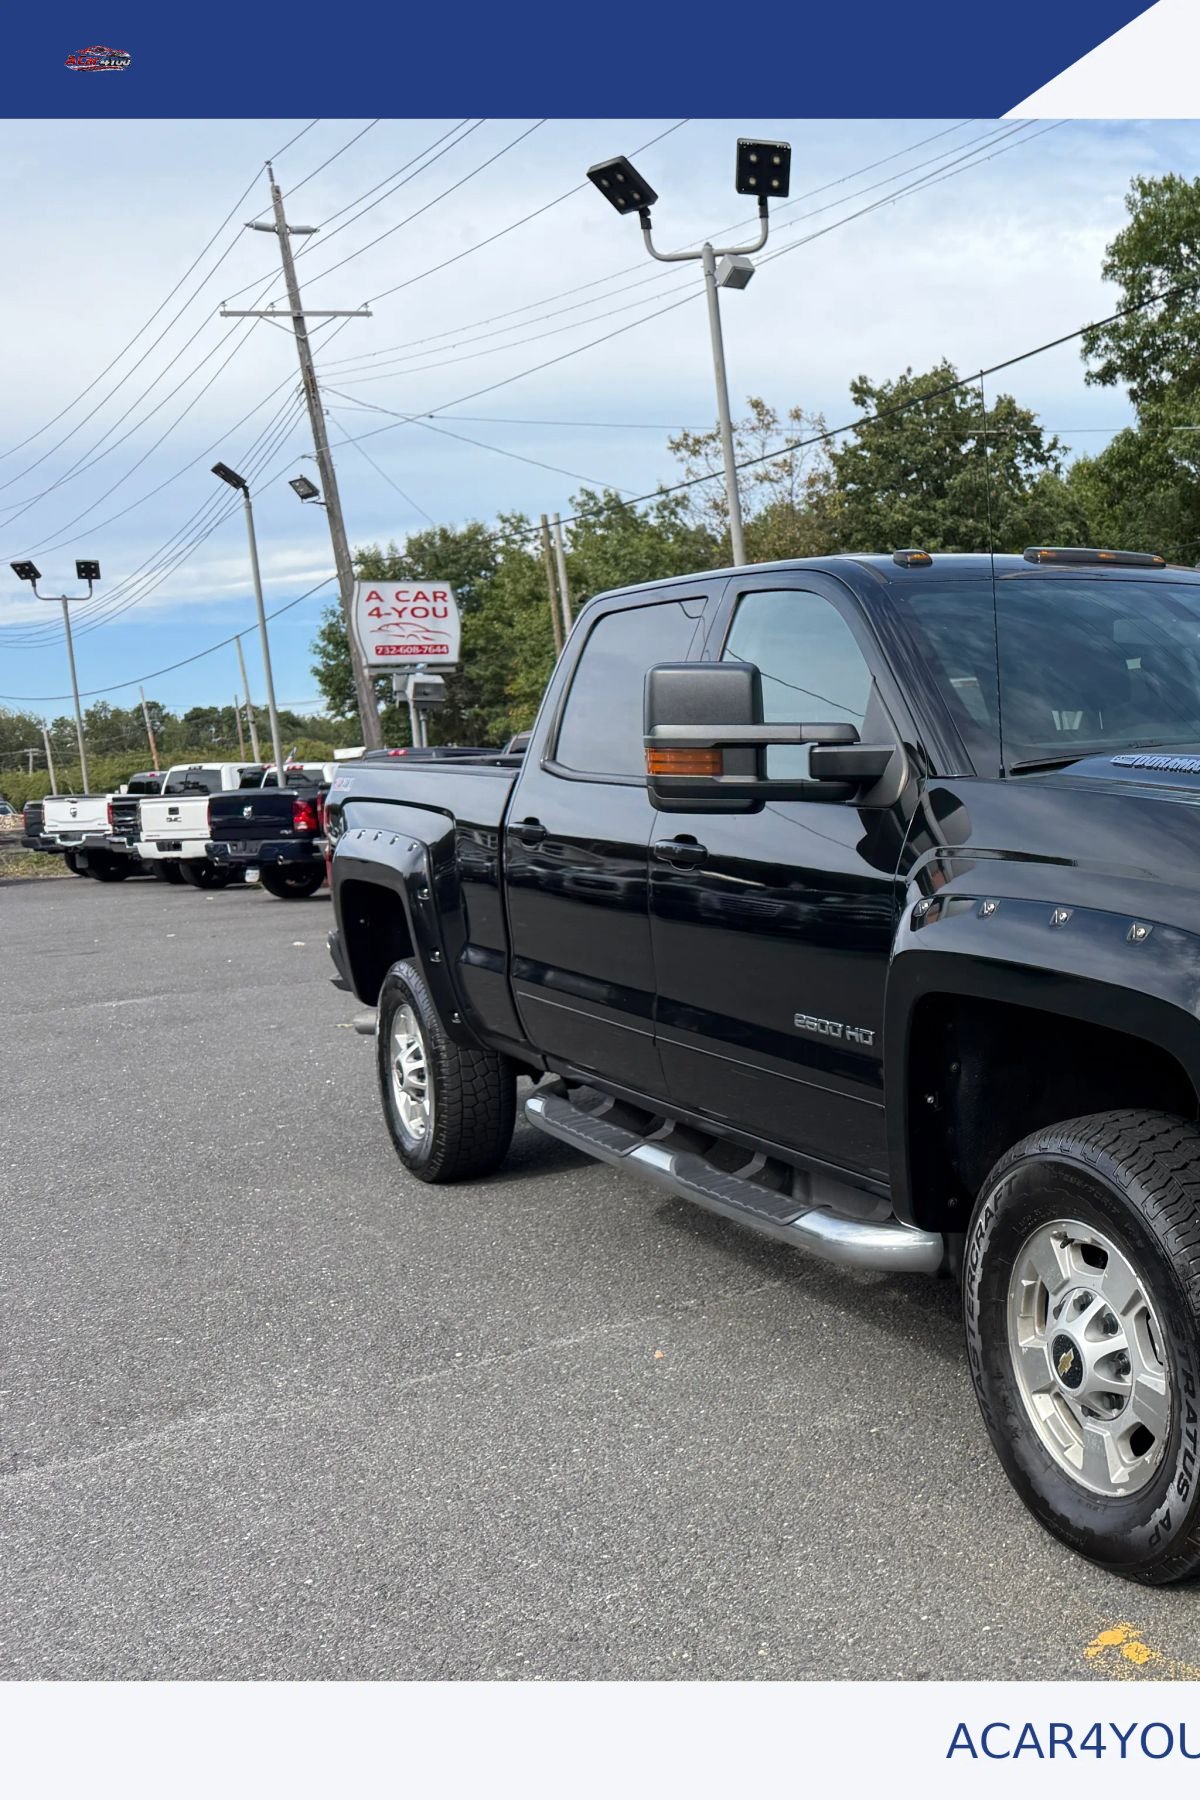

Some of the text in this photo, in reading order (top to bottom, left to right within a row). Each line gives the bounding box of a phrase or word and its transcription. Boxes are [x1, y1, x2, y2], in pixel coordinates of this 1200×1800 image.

[365, 590, 448, 602] A CAR
[368, 606, 448, 619] 4-YOU
[376, 646, 447, 655] 732-608-7644
[794, 1013, 875, 1046] 2500 HD
[1147, 1318, 1200, 1548] STRATUS AP
